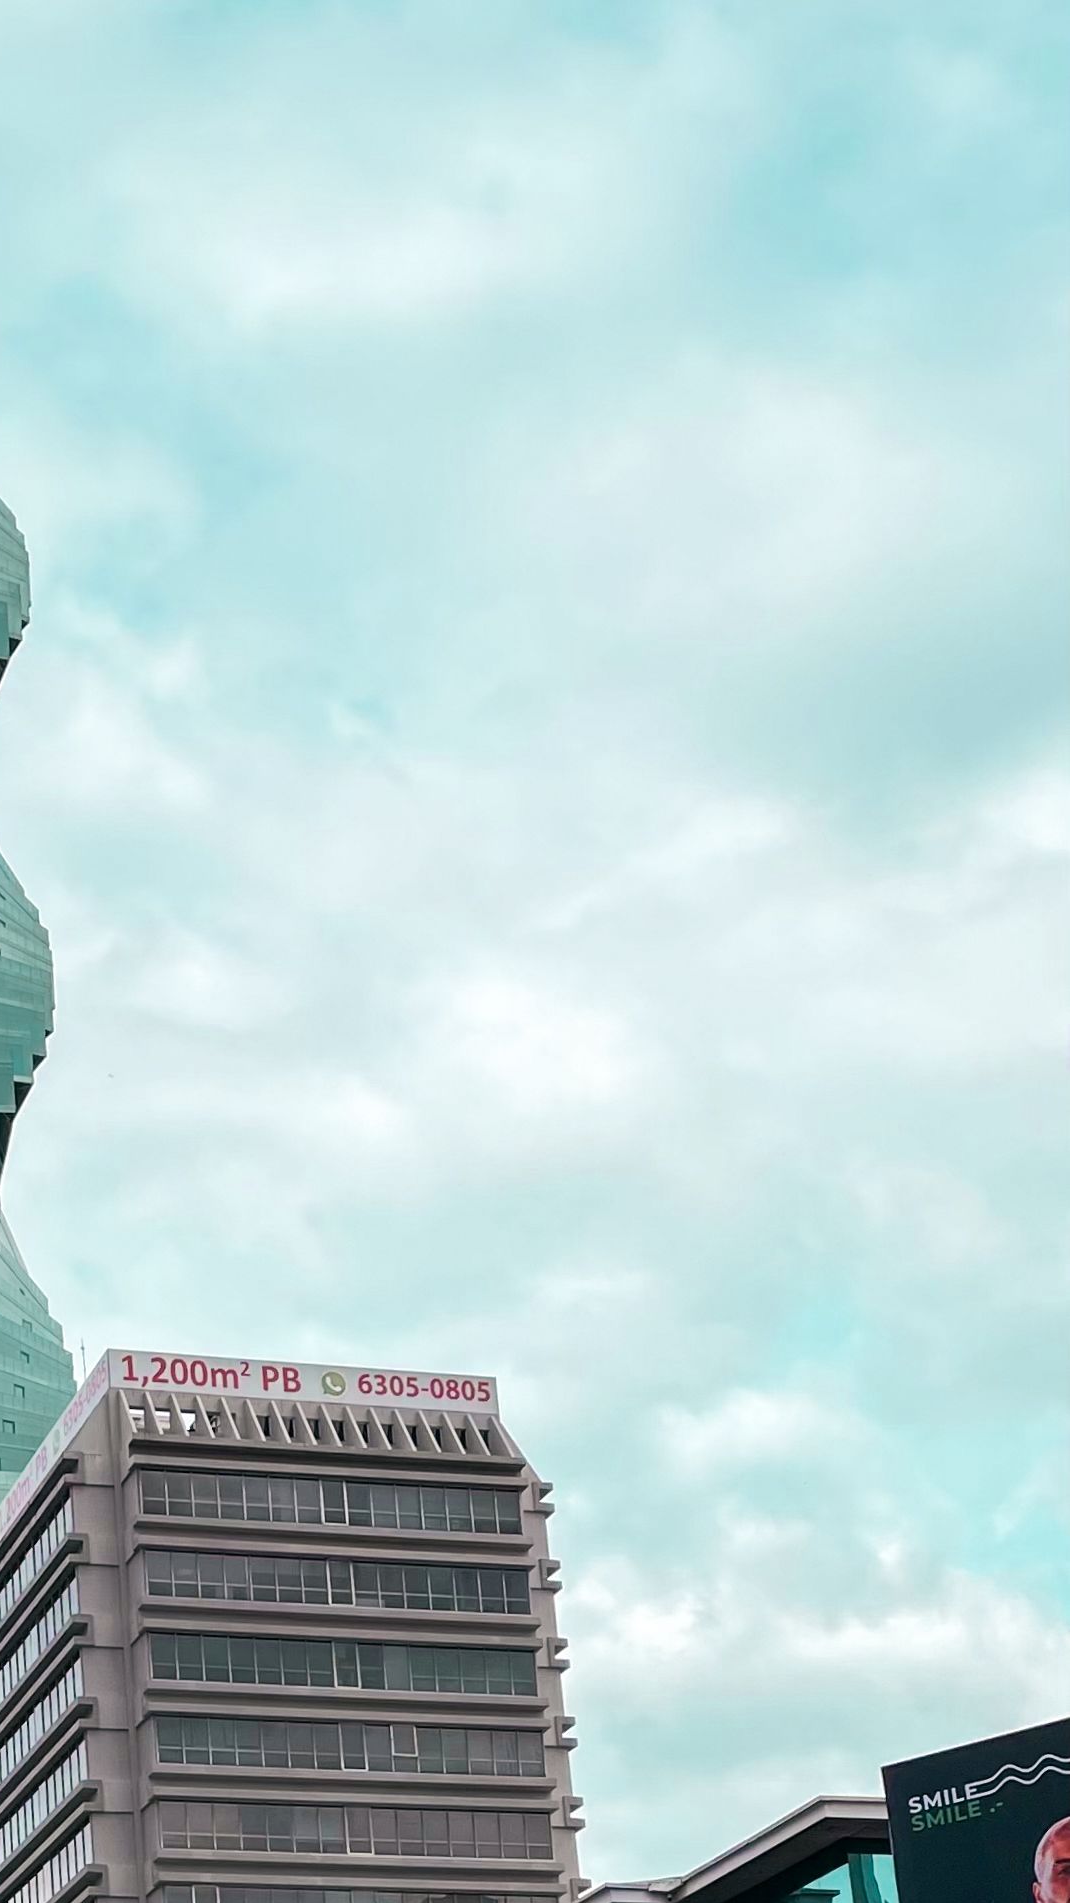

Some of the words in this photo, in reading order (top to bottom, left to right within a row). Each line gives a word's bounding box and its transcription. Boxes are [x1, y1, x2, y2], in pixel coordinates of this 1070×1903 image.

[262, 1366, 301, 1393] PB
[357, 1373, 491, 1402] 6305-0805
[908, 1783, 979, 1814] SMILE
[911, 1800, 982, 1832] SMILE
